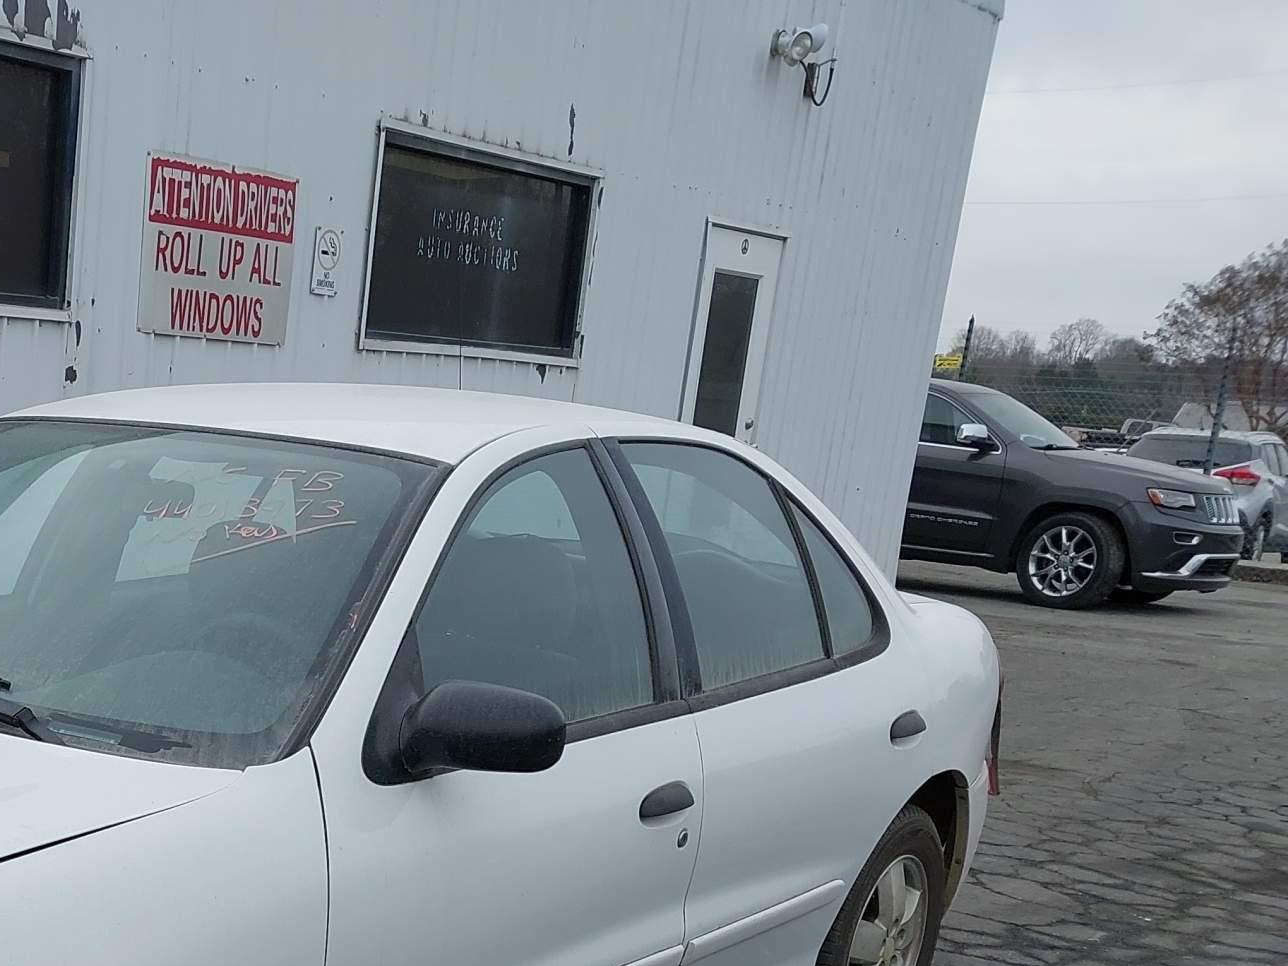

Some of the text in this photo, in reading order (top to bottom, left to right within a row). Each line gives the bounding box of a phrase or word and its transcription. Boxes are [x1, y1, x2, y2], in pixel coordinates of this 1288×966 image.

[150, 165, 294, 236] ATTENTION DRIVERS
[433, 208, 504, 240] INSURANCE
[155, 230, 281, 286] ROLL UP ALL
[170, 287, 263, 338] WINDOWS
